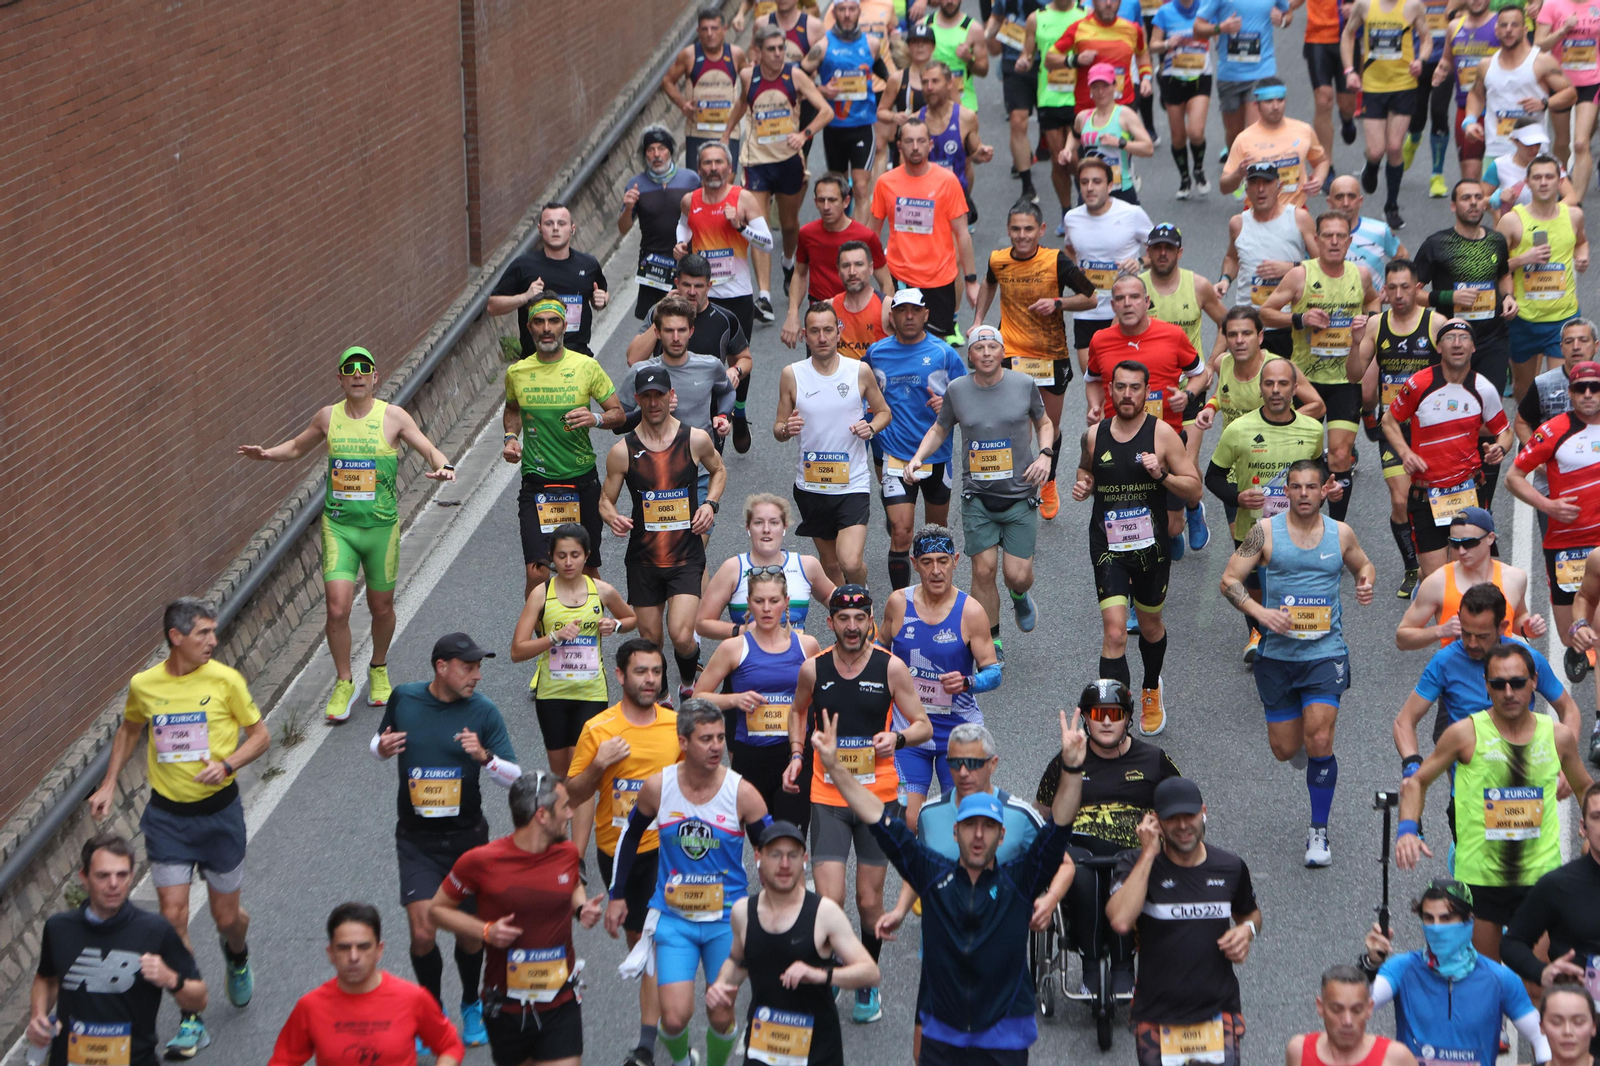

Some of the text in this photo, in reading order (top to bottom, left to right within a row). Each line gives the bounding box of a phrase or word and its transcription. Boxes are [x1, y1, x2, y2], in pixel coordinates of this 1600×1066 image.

[908, 200, 933, 208] ZURICH
[707, 251, 730, 259] ZURICH
[653, 256, 675, 267] ZURICH
[651, 267, 664, 275] 3415
[981, 441, 1006, 449] ZURICH
[820, 453, 844, 461] ZURICH
[981, 455, 997, 463] 5338
[344, 461, 370, 469] ZURICH
[1248, 462, 1276, 470] AMIGOS
[1121, 482, 1158, 492] PIRÁMIDE
[658, 490, 684, 499] ZURICH
[1104, 492, 1147, 502] MIRAFLORES
[658, 504, 675, 512] 6083
[1272, 501, 1288, 509] 7466
[1119, 508, 1144, 518] ZURICH
[1437, 510, 1455, 518] LUCAS
[1121, 523, 1137, 531] 7923
[1121, 534, 1140, 542] JESULI
[1298, 597, 1327, 605] ZURICH
[1297, 612, 1315, 620] 5588
[565, 637, 592, 645] ZURICH
[564, 652, 582, 660] 7736
[918, 684, 936, 693] 7874
[765, 695, 793, 703] ZURICH
[169, 714, 201, 724] ZURICH
[764, 711, 782, 719] 4838
[170, 731, 189, 740] 7584
[840, 739, 868, 747] ZURICH
[839, 755, 858, 763] 3612
[423, 769, 456, 779] ZURICH
[423, 786, 443, 795] 4937
[1504, 789, 1538, 799] ZURICH
[1504, 807, 1525, 816] 5863
[685, 874, 716, 884] ZURICH
[684, 891, 704, 900] 5287
[528, 948, 561, 961] ZURICH
[773, 1011, 806, 1027] ZURICH
[87, 1025, 125, 1036] ZURICH
[1438, 1049, 1475, 1061] ZURICH
